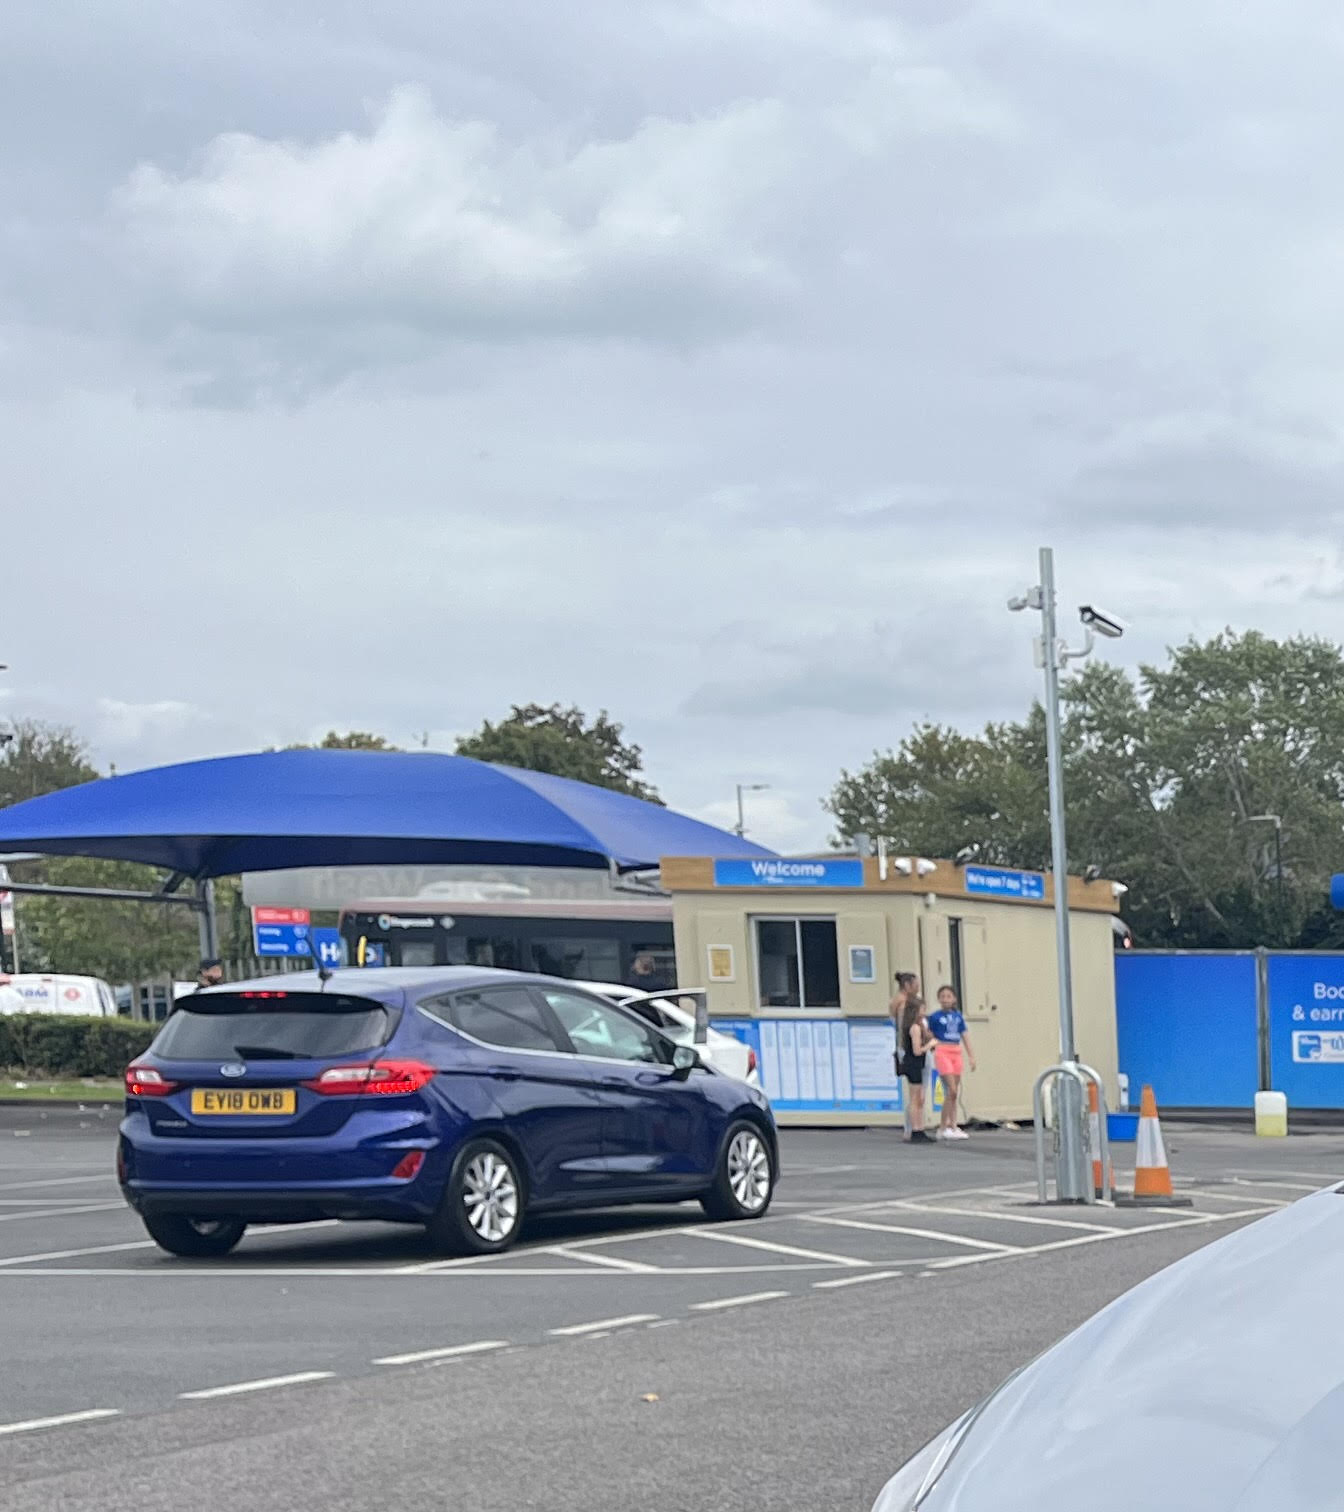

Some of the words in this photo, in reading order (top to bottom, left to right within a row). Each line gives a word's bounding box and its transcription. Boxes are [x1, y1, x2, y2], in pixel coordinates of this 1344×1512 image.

[752, 861, 826, 877] Welcome
[1292, 1004, 1305, 1021] &
[204, 1091, 244, 1110] EY18
